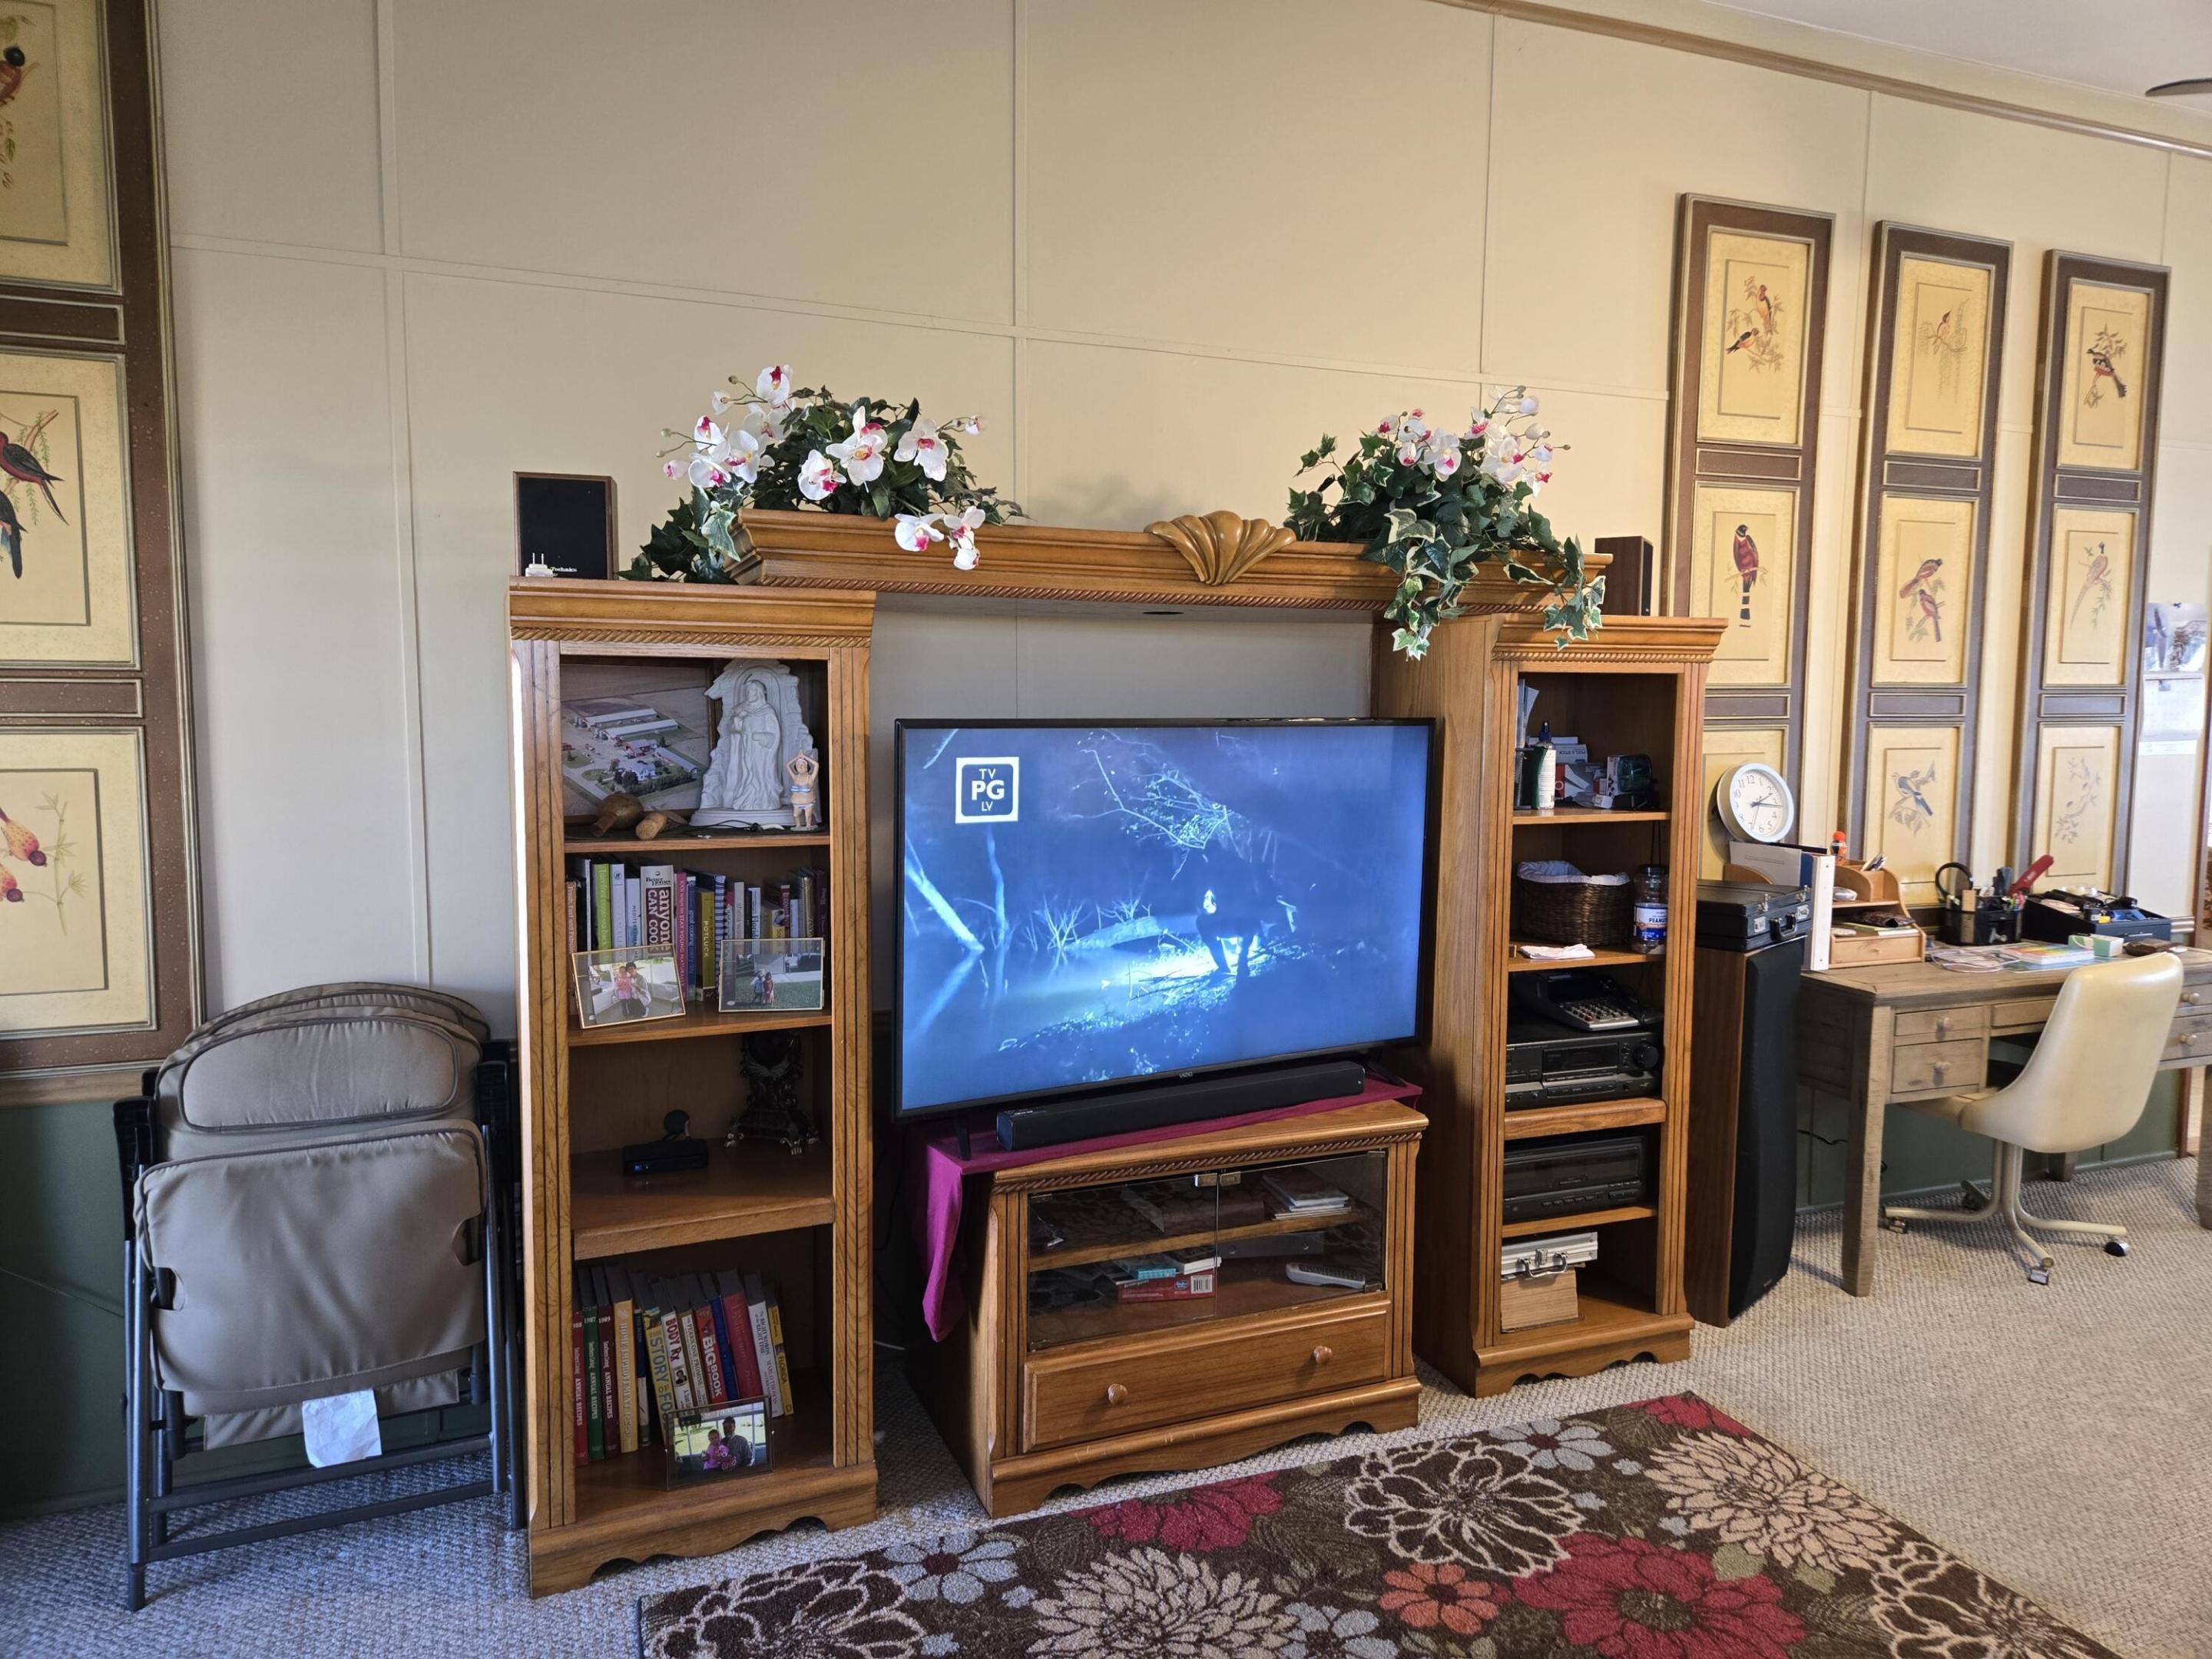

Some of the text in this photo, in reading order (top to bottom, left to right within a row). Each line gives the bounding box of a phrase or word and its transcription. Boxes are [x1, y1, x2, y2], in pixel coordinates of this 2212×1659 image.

[979, 768, 995, 780] TV
[1738, 779, 1745, 787] 11
[1747, 775, 1755, 783] 12
[972, 780, 1005, 800] PG
[982, 801, 993, 811] LV
[648, 890, 657, 915] CAN
[666, 1318, 680, 1346] BODY
[651, 1338, 668, 1382] STORY
[687, 1323, 697, 1357] PERRICONE
[694, 1359, 703, 1386] PROMISE
[703, 1336, 722, 1397] BIG BOOK
[621, 1349, 631, 1409] IMPROVEMENT
[778, 1356, 787, 1383] FLORIDA
